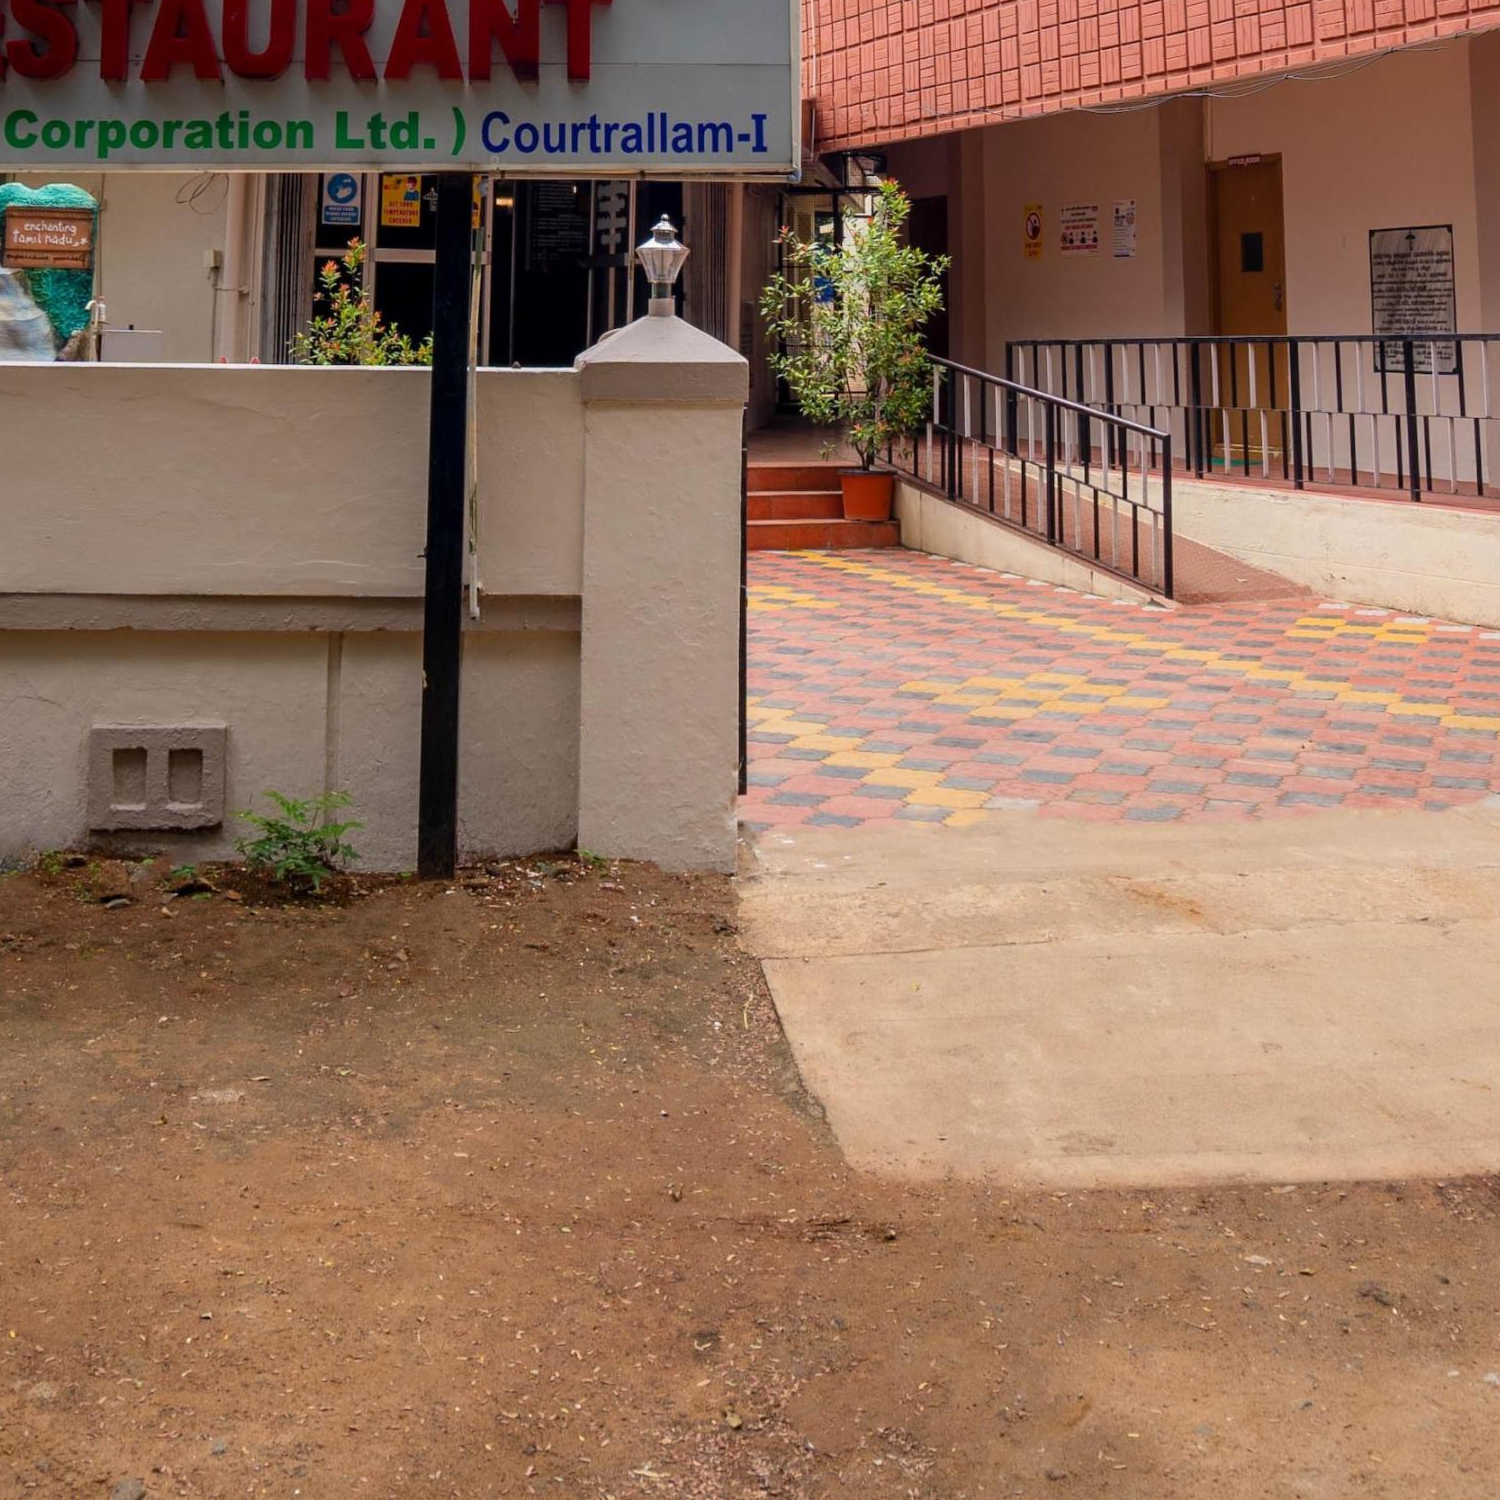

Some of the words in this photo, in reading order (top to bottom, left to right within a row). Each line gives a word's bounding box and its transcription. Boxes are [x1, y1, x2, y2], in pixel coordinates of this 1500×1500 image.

[4, 109, 314, 158] Corporation
[481, 111, 767, 154] Courtrallam-I
[13, 228, 42, 244] tamil
[45, 233, 73, 246] nadu
[24, 220, 76, 236] enchanting
